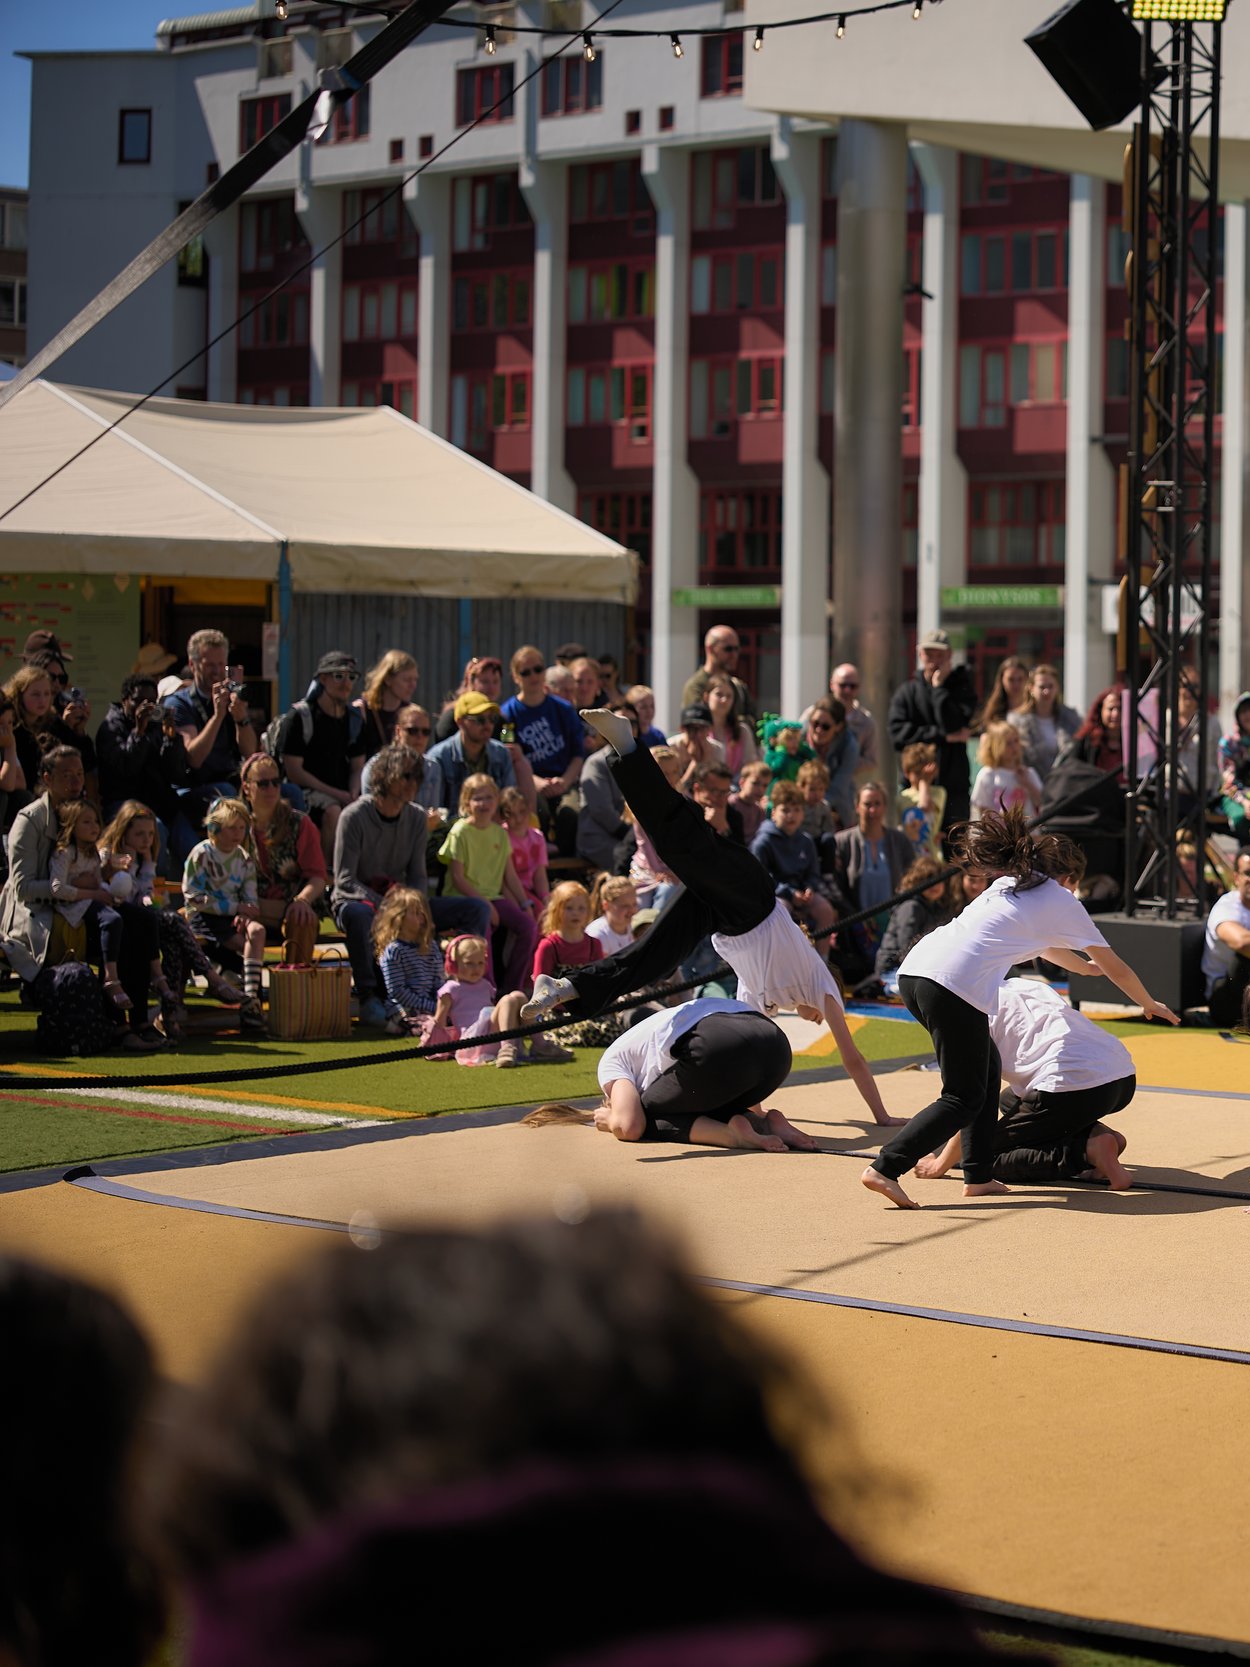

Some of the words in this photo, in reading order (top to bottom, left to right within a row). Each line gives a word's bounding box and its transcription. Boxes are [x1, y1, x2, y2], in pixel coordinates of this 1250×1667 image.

[518, 716, 550, 743] JOIN
[526, 728, 555, 751] THE
[527, 735, 565, 762] IRCUS
